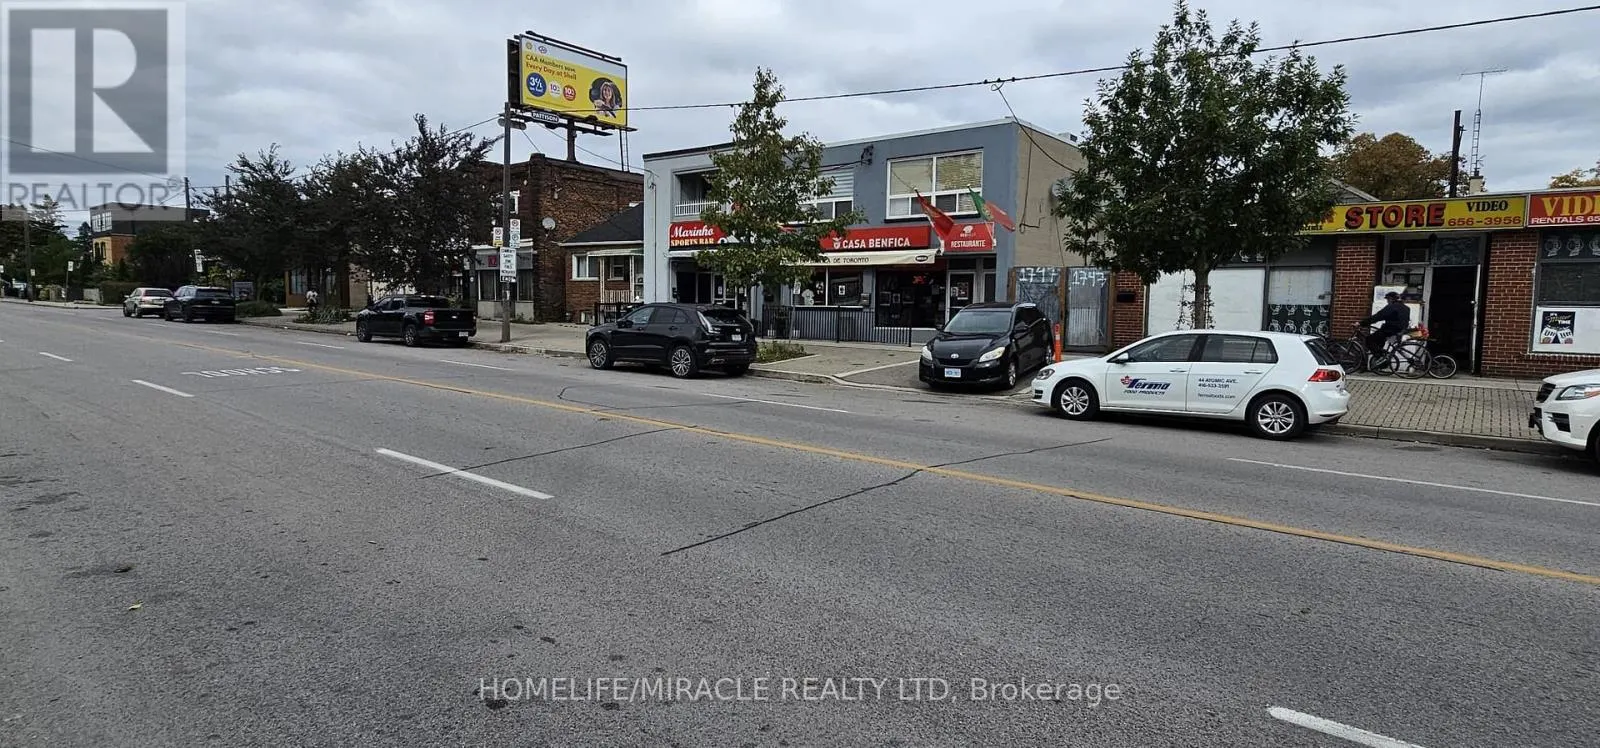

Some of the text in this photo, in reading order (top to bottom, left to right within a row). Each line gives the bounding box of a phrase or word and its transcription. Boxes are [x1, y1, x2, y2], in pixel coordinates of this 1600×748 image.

[532, 112, 559, 122] PATTISON
[1466, 200, 1508, 212] VIDEO
[1345, 203, 1446, 229] STORE
[1448, 216, 1521, 226] 656-3956
[1531, 216, 1585, 224] RENTALS
[671, 225, 714, 238] Marinho
[671, 239, 698, 247] SPORTS
[842, 237, 911, 249] CASA BENFICA
[950, 239, 986, 248] RESTAURANTE
[1019, 266, 1059, 282] 1747
[1072, 270, 1107, 287] 1747
